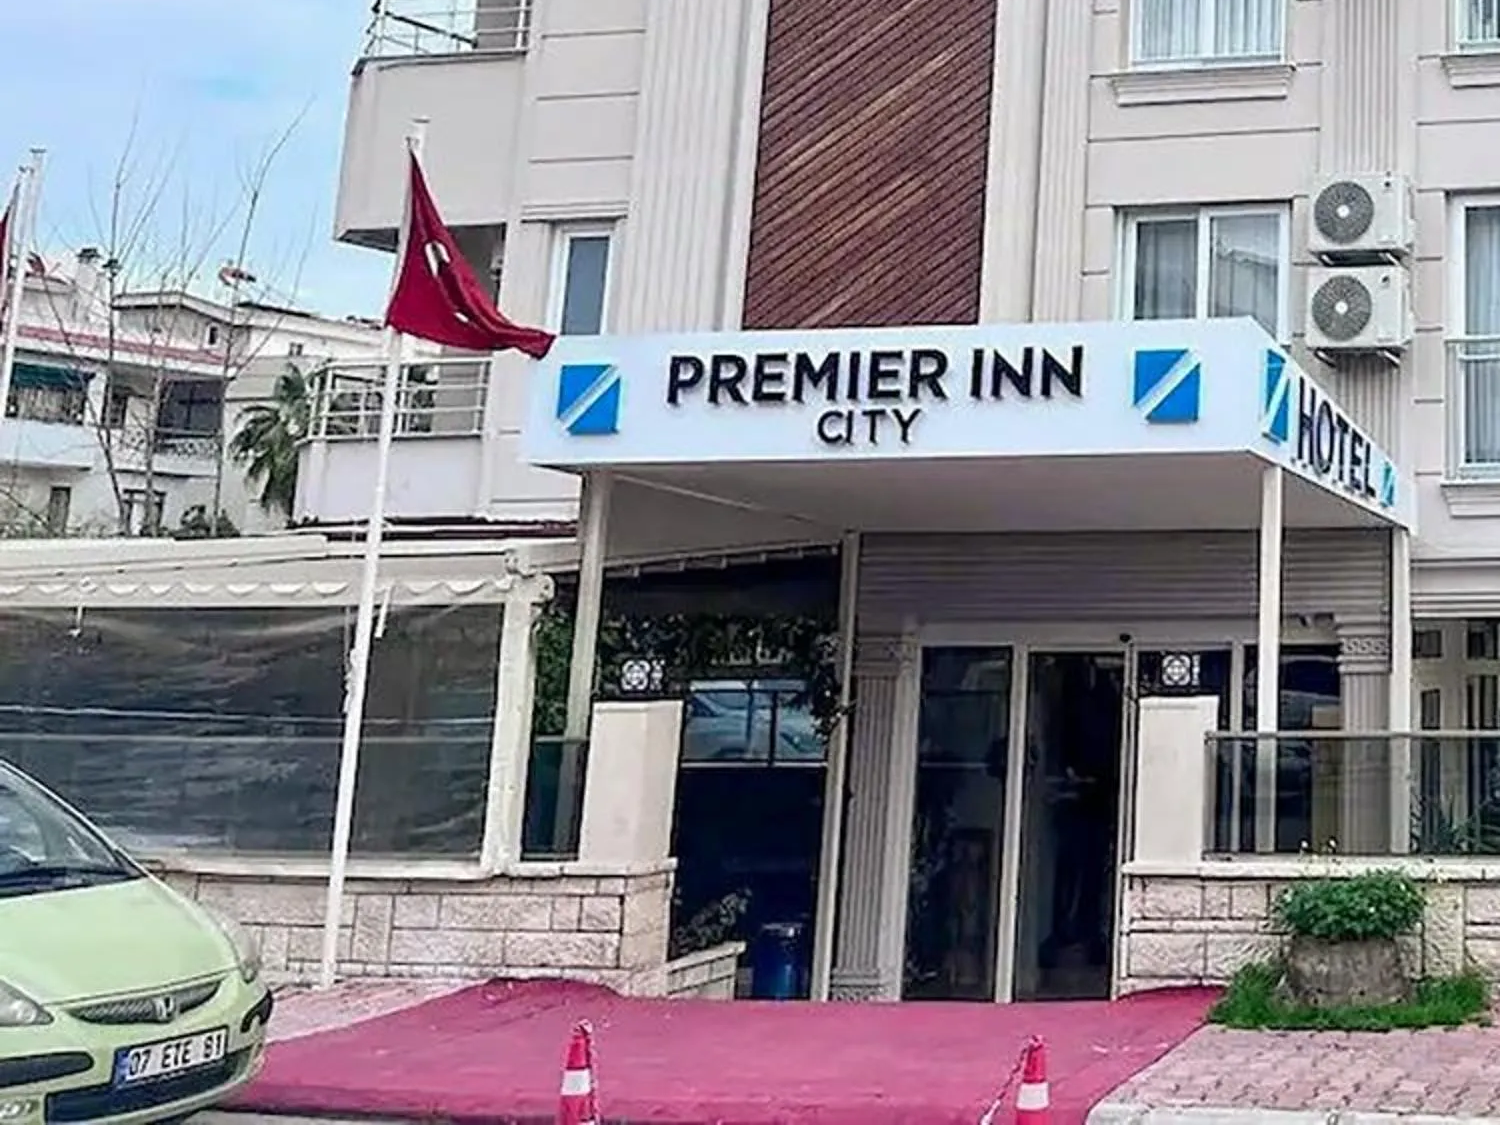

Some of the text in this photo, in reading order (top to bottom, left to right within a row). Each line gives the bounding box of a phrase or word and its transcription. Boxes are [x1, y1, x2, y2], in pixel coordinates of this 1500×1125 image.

[667, 345, 1083, 405] PREMIER INN
[817, 409, 921, 445] CITY
[1298, 376, 1376, 497] HOTEL
[129, 1049, 151, 1076] 07
